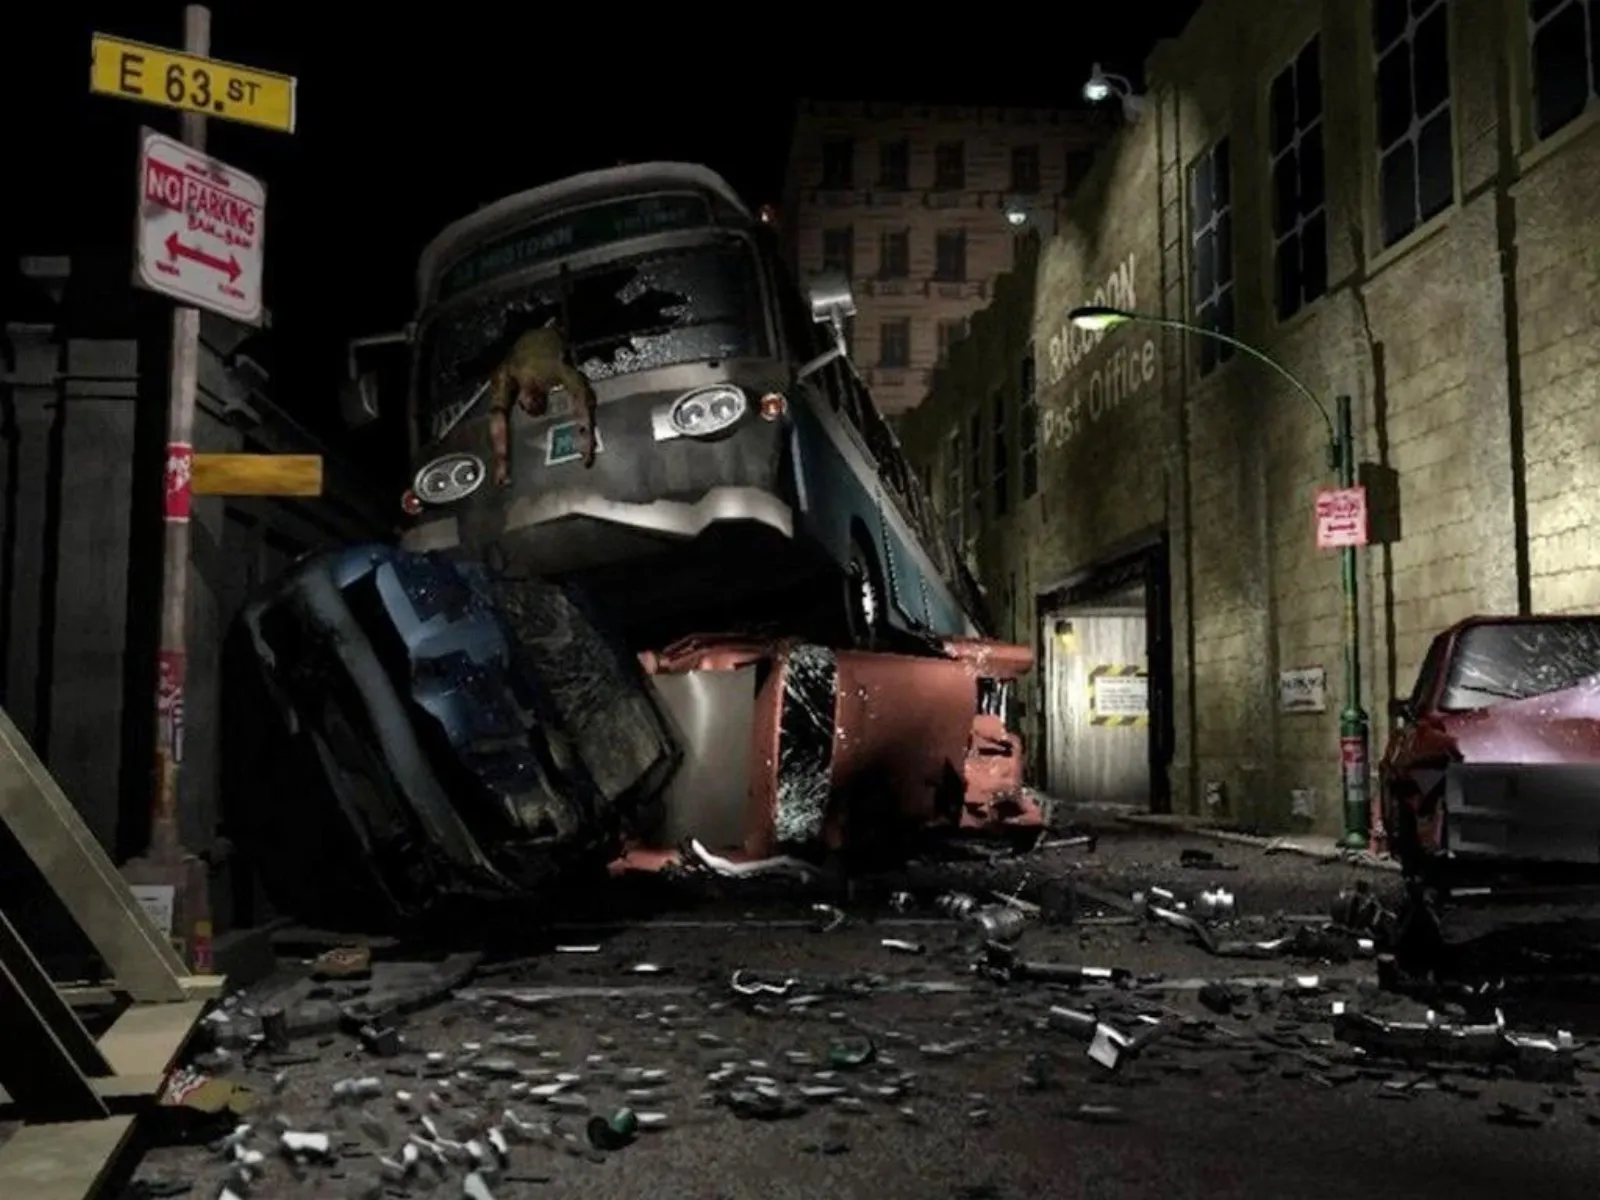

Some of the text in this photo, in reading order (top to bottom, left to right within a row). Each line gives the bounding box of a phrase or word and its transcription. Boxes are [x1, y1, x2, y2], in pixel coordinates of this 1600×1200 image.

[119, 53, 144, 95] E
[226, 78, 261, 106] ST
[147, 166, 182, 205] NO
[186, 181, 255, 237] PARKING
[1088, 338, 1156, 423] Office
